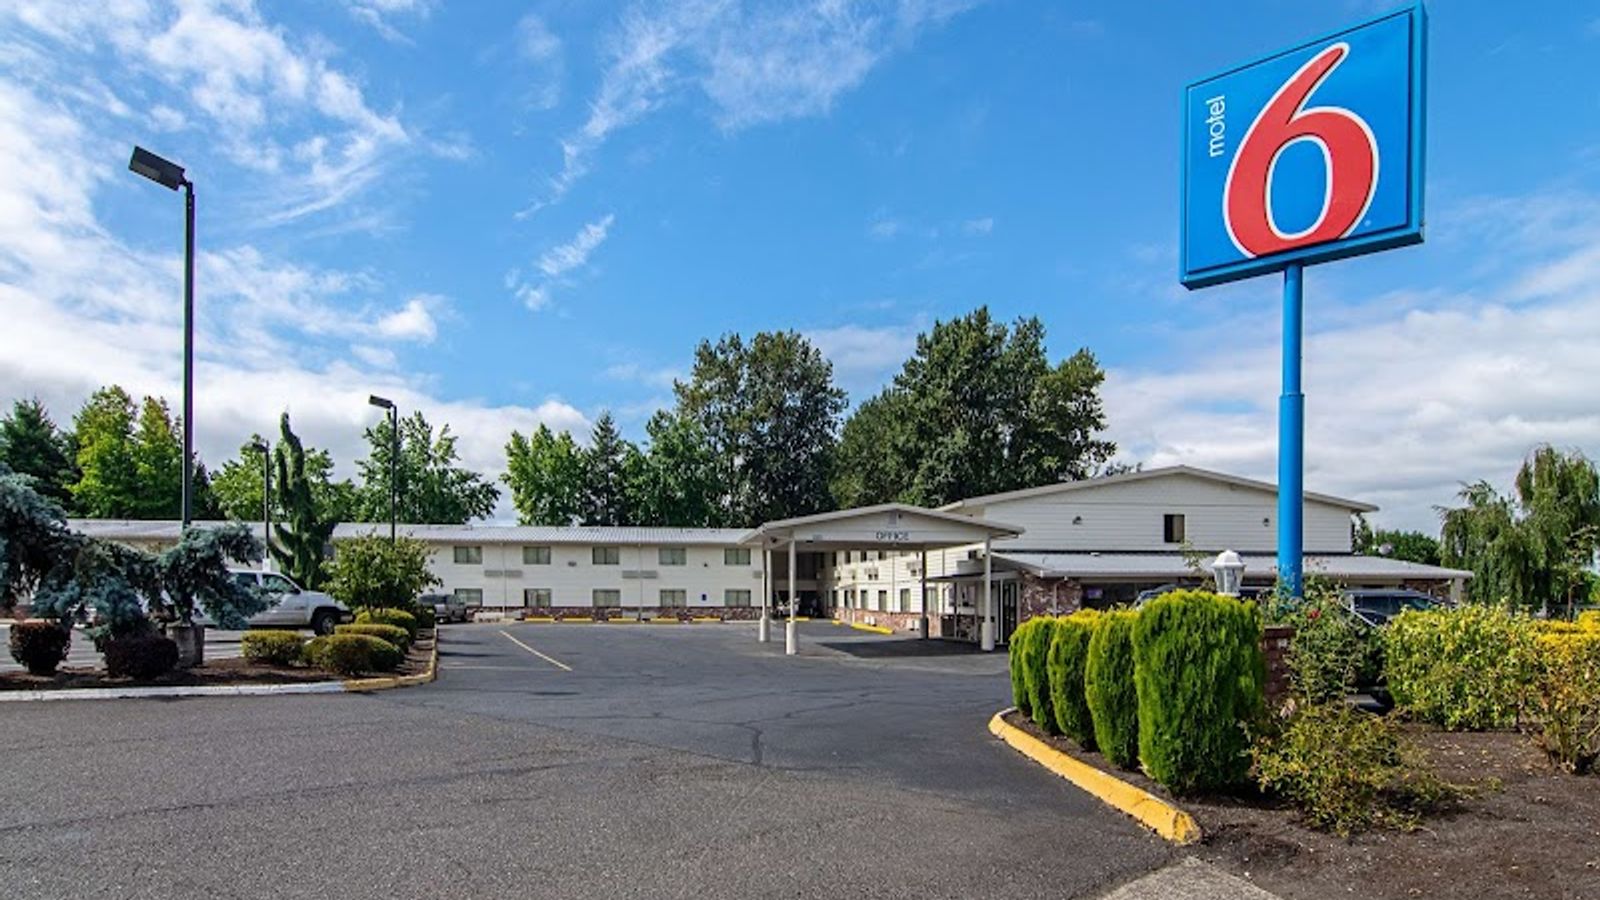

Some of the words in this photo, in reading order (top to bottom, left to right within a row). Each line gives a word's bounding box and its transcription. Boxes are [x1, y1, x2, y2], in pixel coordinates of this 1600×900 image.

[1205, 95, 1225, 157] motel
[1222, 42, 1379, 259] 6
[876, 531, 909, 541] OFFICE
